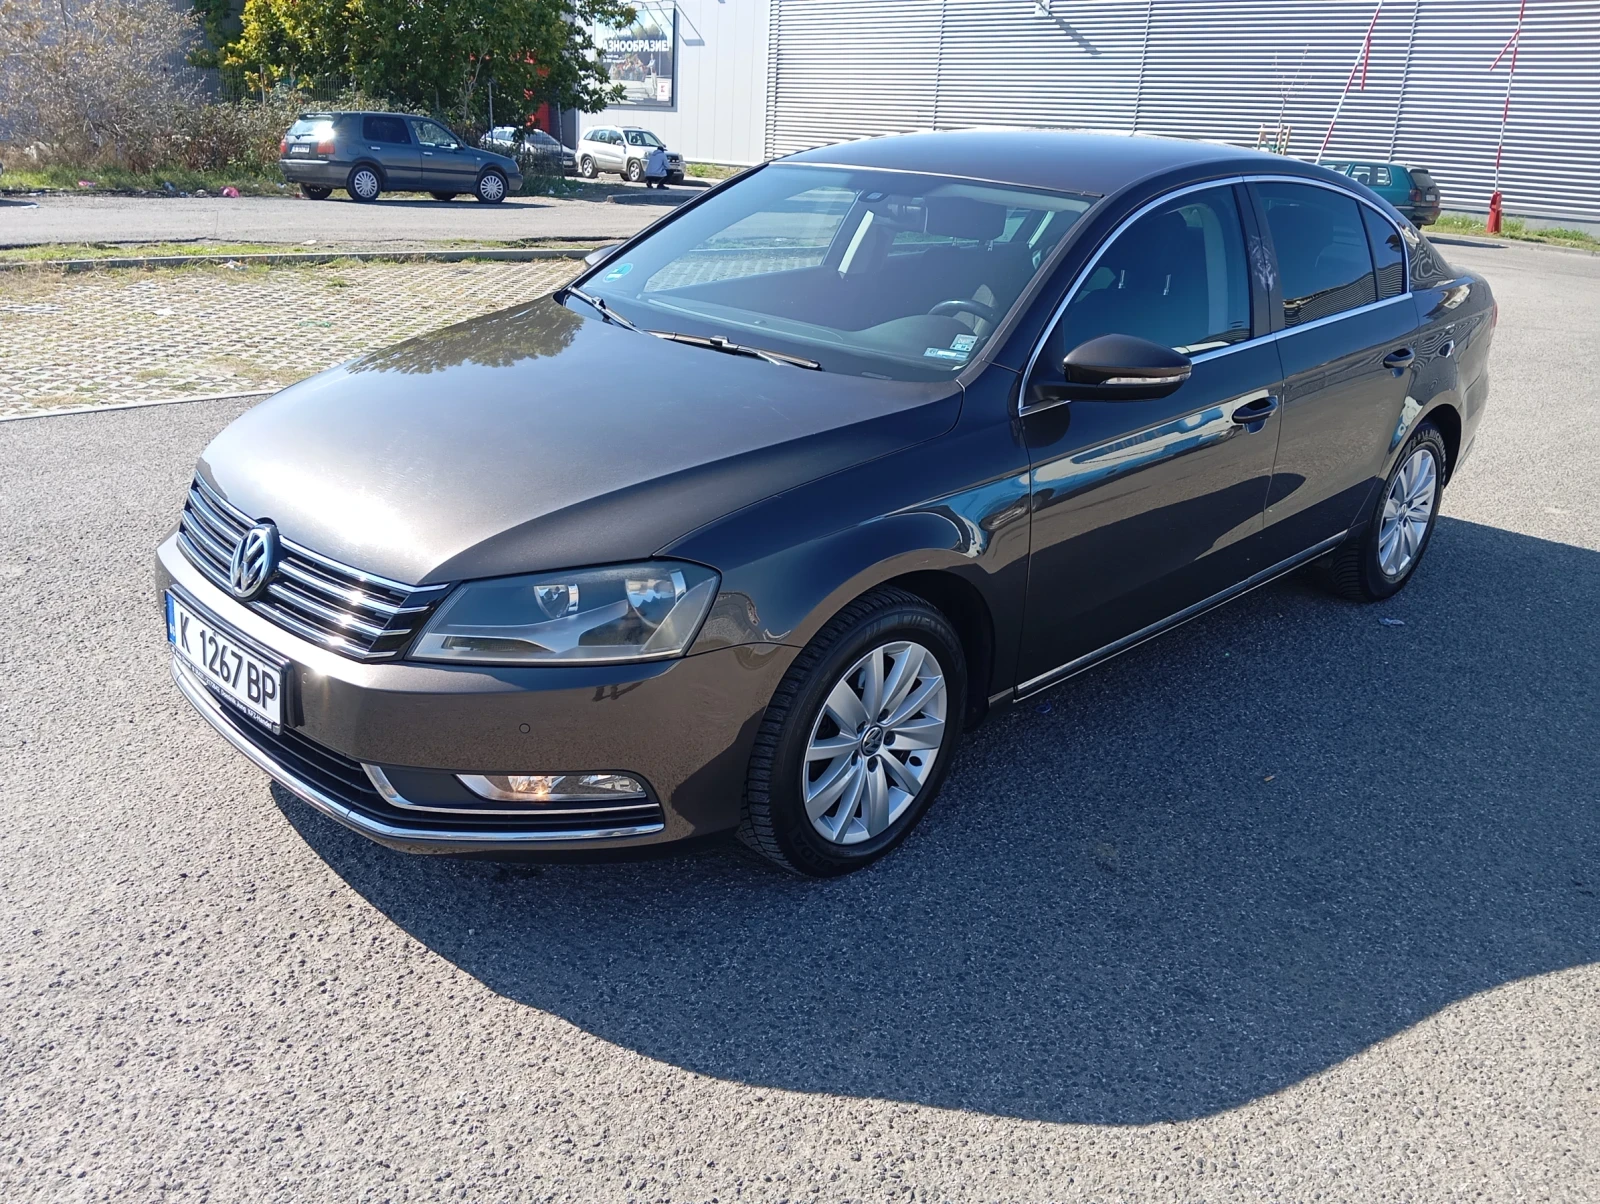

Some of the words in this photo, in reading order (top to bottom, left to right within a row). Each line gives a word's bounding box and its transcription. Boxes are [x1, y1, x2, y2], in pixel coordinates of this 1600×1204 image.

[602, 39, 670, 52] АЗНООБРАЗИЕ!
[180, 611, 192, 655] K
[199, 629, 244, 690] 1267
[247, 660, 277, 711] BP
